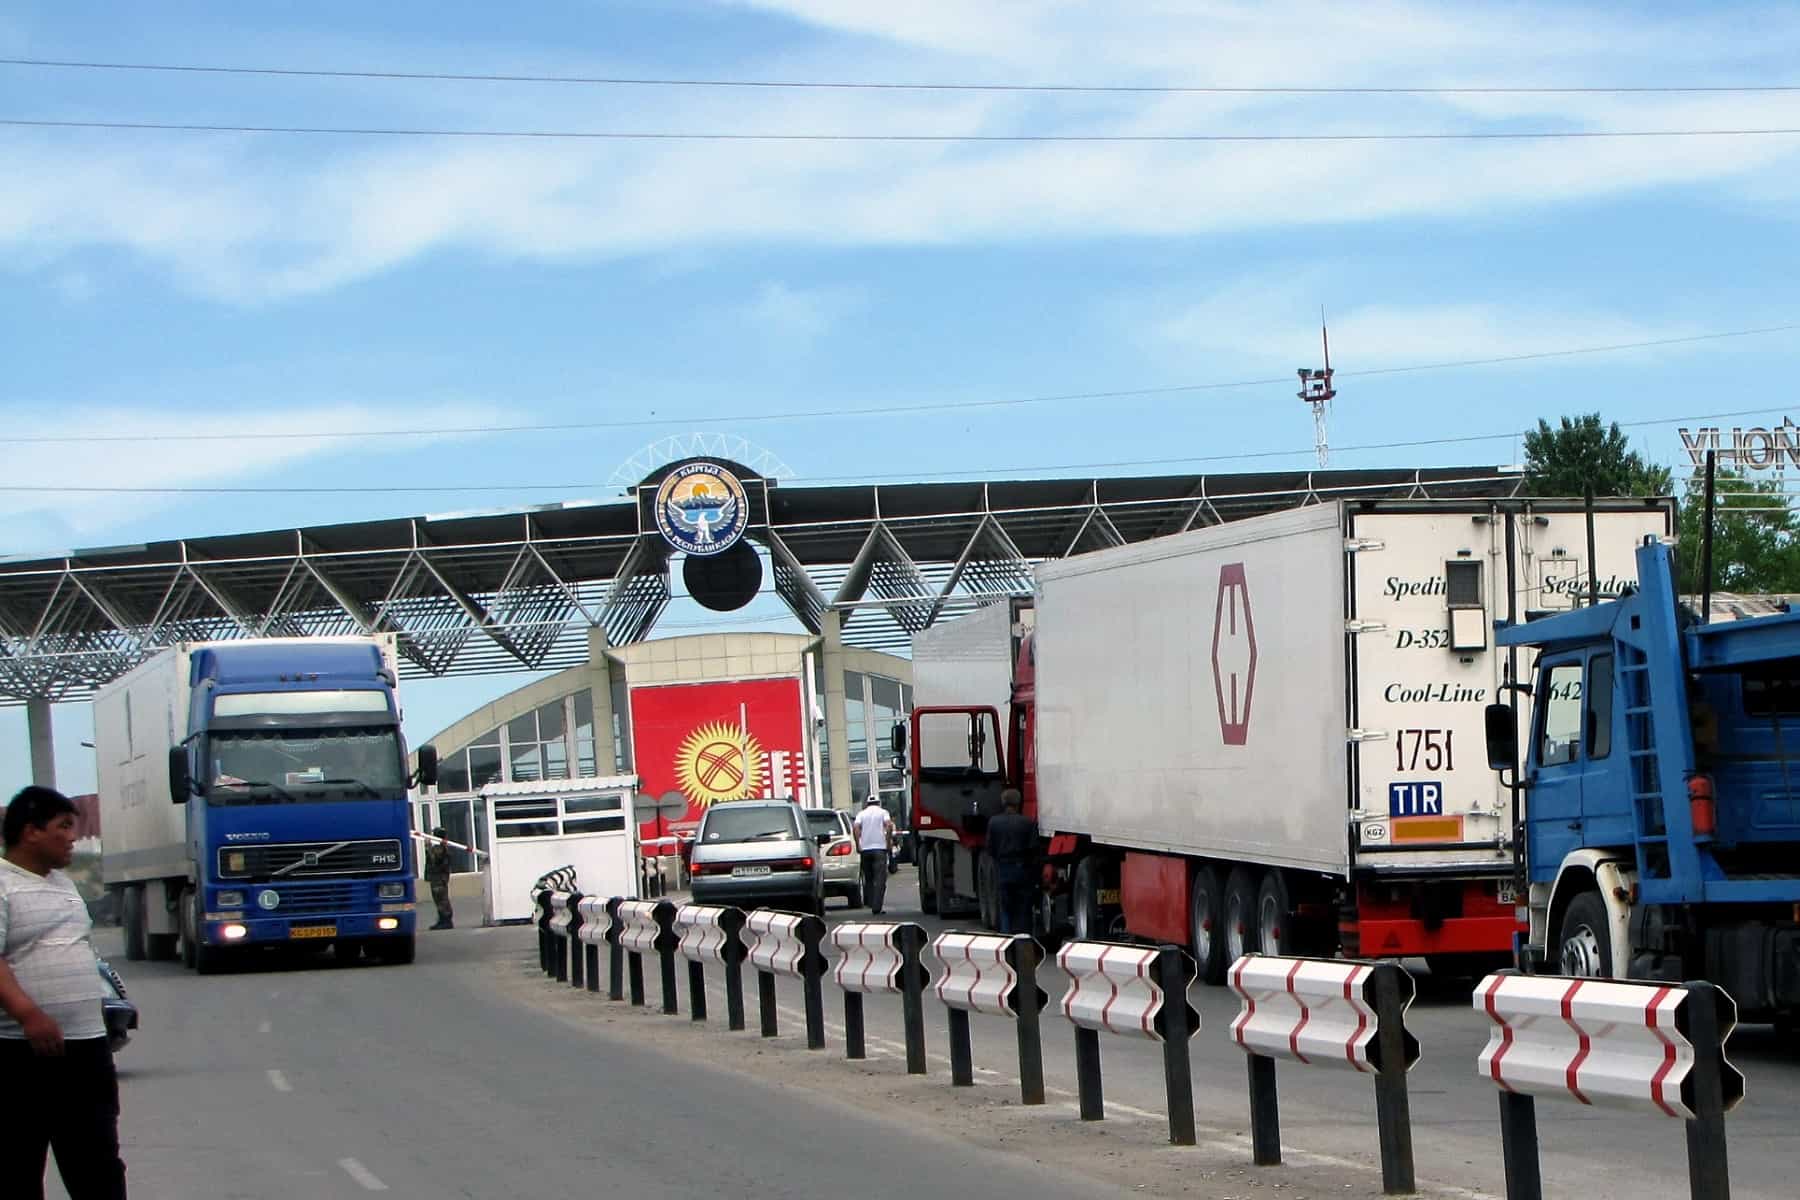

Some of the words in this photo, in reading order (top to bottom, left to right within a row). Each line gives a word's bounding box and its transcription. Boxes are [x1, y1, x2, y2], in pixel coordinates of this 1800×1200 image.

[1396, 629, 1448, 648] D-352
[1384, 683, 1485, 702] Cool-Line
[1396, 729, 1453, 771] 1751
[1393, 785, 1438, 814] TIR
